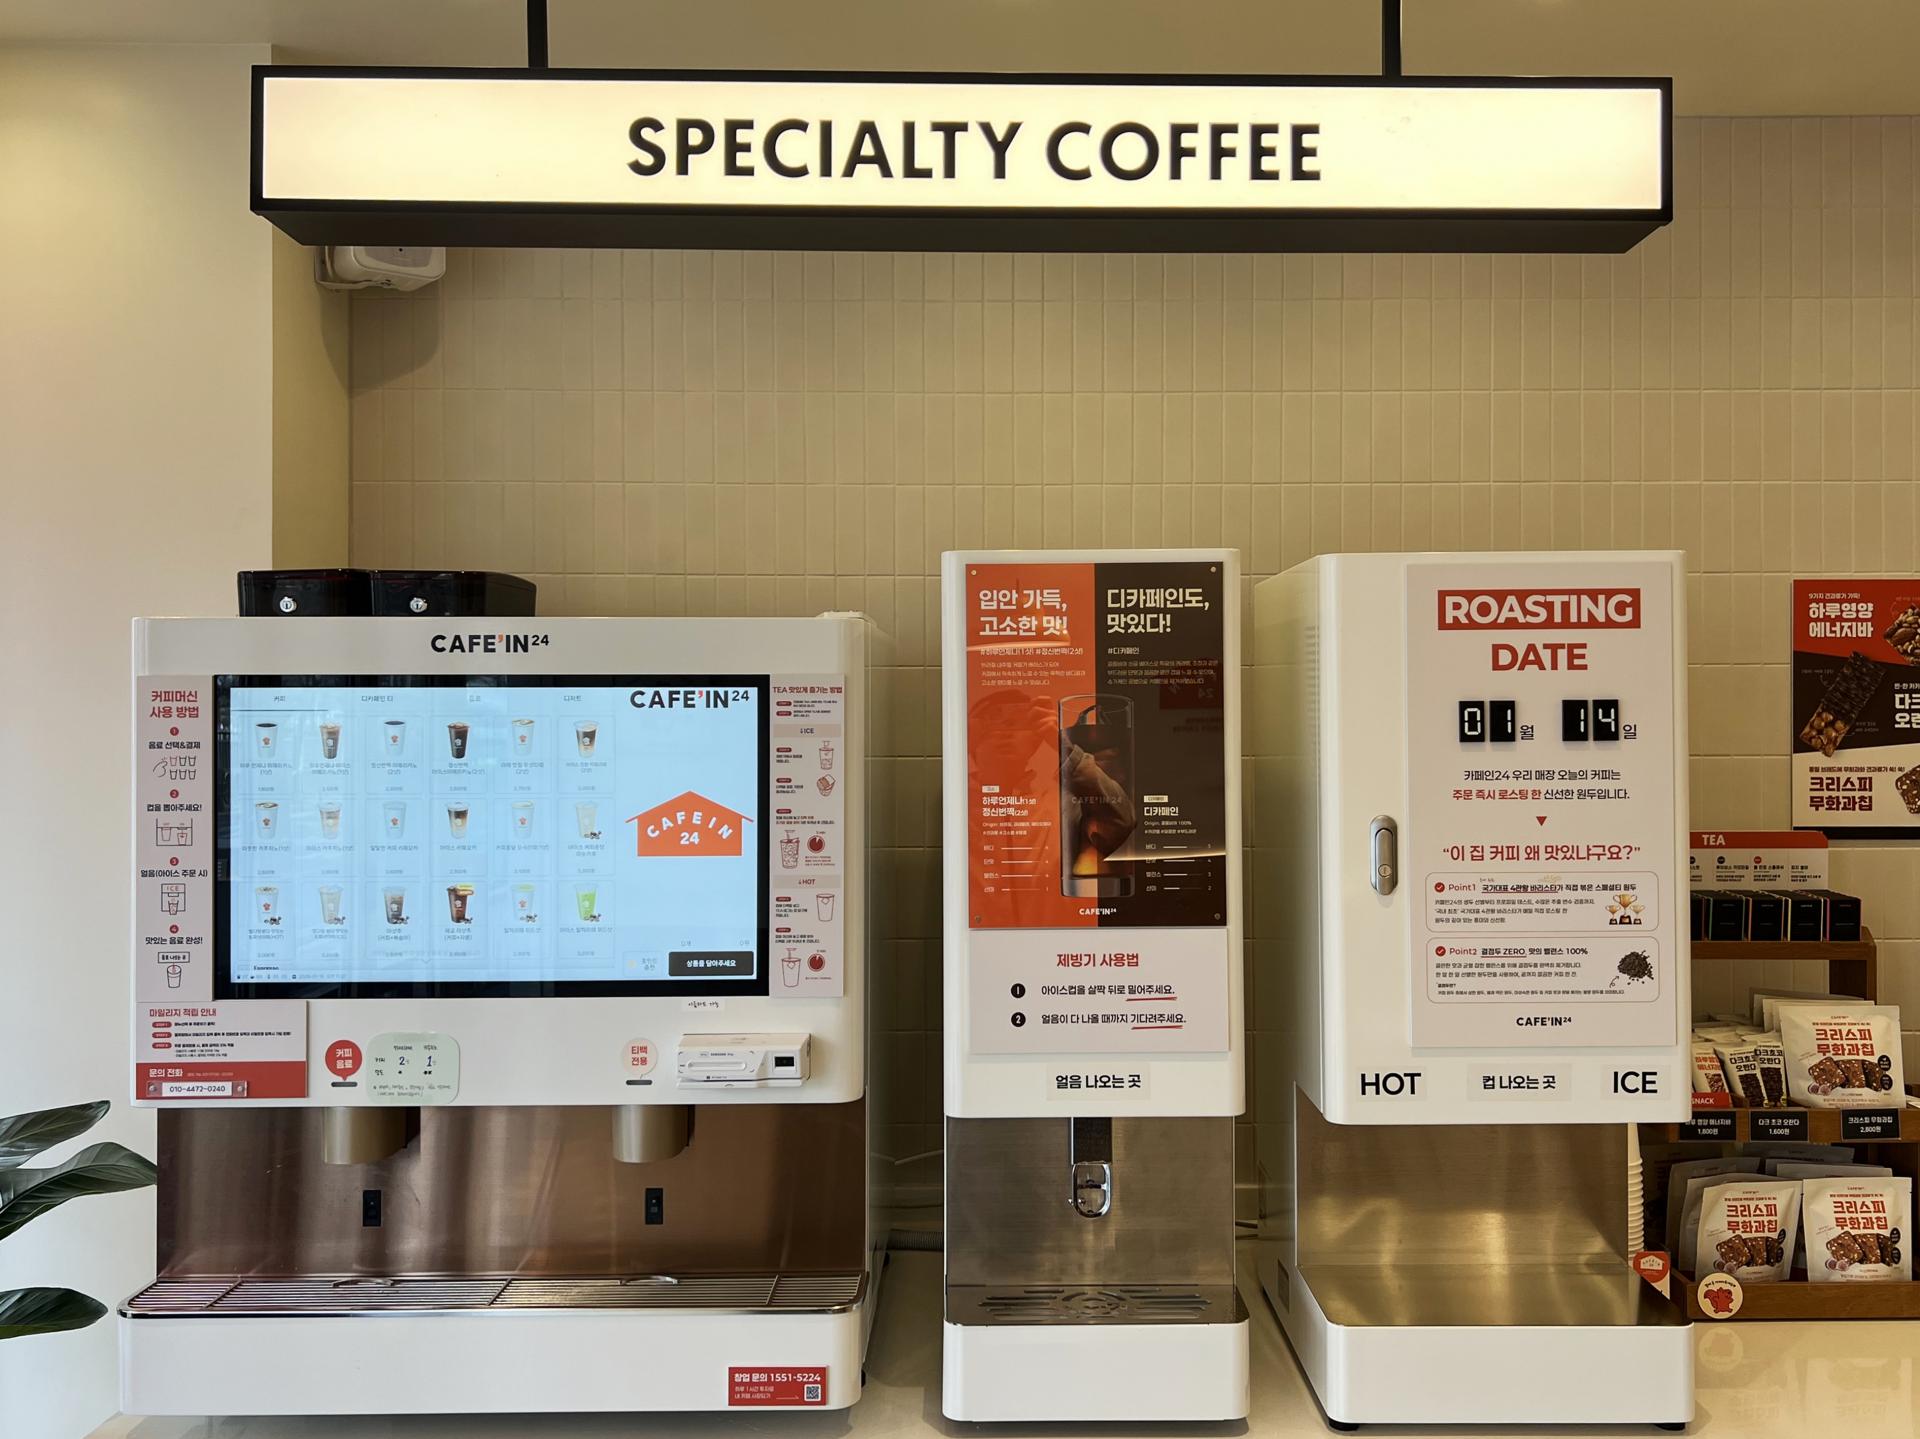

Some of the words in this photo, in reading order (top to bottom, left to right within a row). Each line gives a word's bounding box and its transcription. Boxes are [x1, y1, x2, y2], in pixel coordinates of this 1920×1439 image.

[628, 117, 1023, 179] SPECIALTY
[1046, 121, 1321, 182] COFFEE
[979, 589, 1018, 610] 입안
[1023, 589, 1067, 612] 가득,
[1107, 588, 1210, 611] 디카페인도,
[1444, 594, 1634, 624] ROASTING
[1809, 602, 1874, 618] 하루영양
[979, 616, 1038, 636] 고소한
[1042, 616, 1067, 636] 맛!
[1107, 613, 1171, 634] 맛있다!
[1809, 622, 1874, 638] 에너지바
[1107, 647, 1140, 655] #디카페인
[1491, 642, 1588, 671] DATE
[152, 691, 198, 703] 커피머신
[630, 690, 750, 709] CAFE'IN24
[150, 706, 172, 718] 사용
[176, 706, 199, 718] 방법
[1520, 724, 1535, 740] 월
[1580, 708, 1615, 733] 14
[1623, 724, 1637, 740] 일
[149, 741, 163, 749] 음료
[165, 741, 200, 749] 선택&결제
[1464, 770, 1510, 781] 카페인24
[1512, 770, 1532, 781] 우리
[1535, 770, 1555, 780] 매장
[1557, 770, 1588, 780] 오늘의
[1590, 769, 1621, 780] 커피는
[1809, 776, 1873, 792] 크리스피
[1453, 789, 1473, 800] 주문
[1475, 789, 1496, 800] 즉시
[1498, 789, 1528, 800] 로스팅
[1531, 789, 1542, 800] 한
[1543, 789, 1574, 799] 신선한
[1576, 788, 1630, 799] 원두입니다.
[147, 804, 161, 812] 컵을
[163, 804, 202, 812] 뽑아주세요!
[1809, 795, 1873, 811] 무화과칩
[1144, 806, 1179, 816] 디카페인
[646, 811, 733, 840] CAFEIN
[680, 832, 700, 845] 24
[1702, 834, 1726, 846] TEA
[1470, 846, 1485, 861] 집
[1489, 845, 1519, 861] 커피
[1524, 845, 1540, 861] 왜
[141, 869, 180, 878] 얼음(아이스
[181, 869, 196, 878] 주문
[198, 869, 208, 878] 시)
[1482, 884, 1509, 892] 국가대표
[1530, 884, 1563, 892] 바리스타가
[145, 937, 167, 945] 맛있는
[169, 937, 184, 945] 음료
[186, 937, 203, 945] 완성!
[705, 959, 736, 967] 담아주세요
[1056, 953, 1096, 968] 제빙기
[1099, 953, 1139, 967] 사용법
[1016, 986, 1020, 995] 1
[1041, 985, 1086, 996] 아이스컵을
[1088, 985, 1106, 995] 살짝
[1108, 985, 1126, 995] 뒤로
[1128, 985, 1175, 995] 밀어주세요.
[150, 1008, 181, 1017] 마일리지
[183, 1008, 199, 1017] 적립
[201, 1008, 217, 1016] 안내
[1041, 1014, 1068, 1024] 얼음이
[1071, 1014, 1079, 1024] 다
[1081, 1014, 1099, 1024] 나올
[1101, 1014, 1128, 1024] 때까지
[1130, 1013, 1187, 1024] 기다려주세요.
[1815, 1028, 1873, 1041] 크리스피
[336, 1049, 353, 1057] 커피
[632, 1046, 648, 1054] 티백
[1816, 1043, 1875, 1056] 무화과칩
[336, 1060, 353, 1069] 음료
[632, 1057, 647, 1066] 전용
[1735, 1063, 1757, 1072] 오란다
[149, 1069, 166, 1078] 문의
[167, 1068, 183, 1077] 전화
[1056, 1074, 1082, 1090] 얼음
[1085, 1074, 1125, 1089] 나오는
[1128, 1074, 1141, 1088] 곳
[1361, 1072, 1421, 1096] HOT
[1482, 1075, 1496, 1090] 컵
[1500, 1075, 1539, 1089] 나오는
[1543, 1075, 1556, 1089] 곳
[1613, 1071, 1658, 1094] ICE
[169, 1085, 226, 1093] 010-4472-0240
[1783, 1118, 1800, 1126] 오란다
[1726, 1204, 1778, 1217] 크리스피
[1833, 1200, 1886, 1214] 크리스피
[1726, 1220, 1778, 1234] 무화과칩
[1834, 1216, 1889, 1230] 무화과칩
[752, 1373, 767, 1382] 문의
[770, 1373, 821, 1382] 1551-5224
